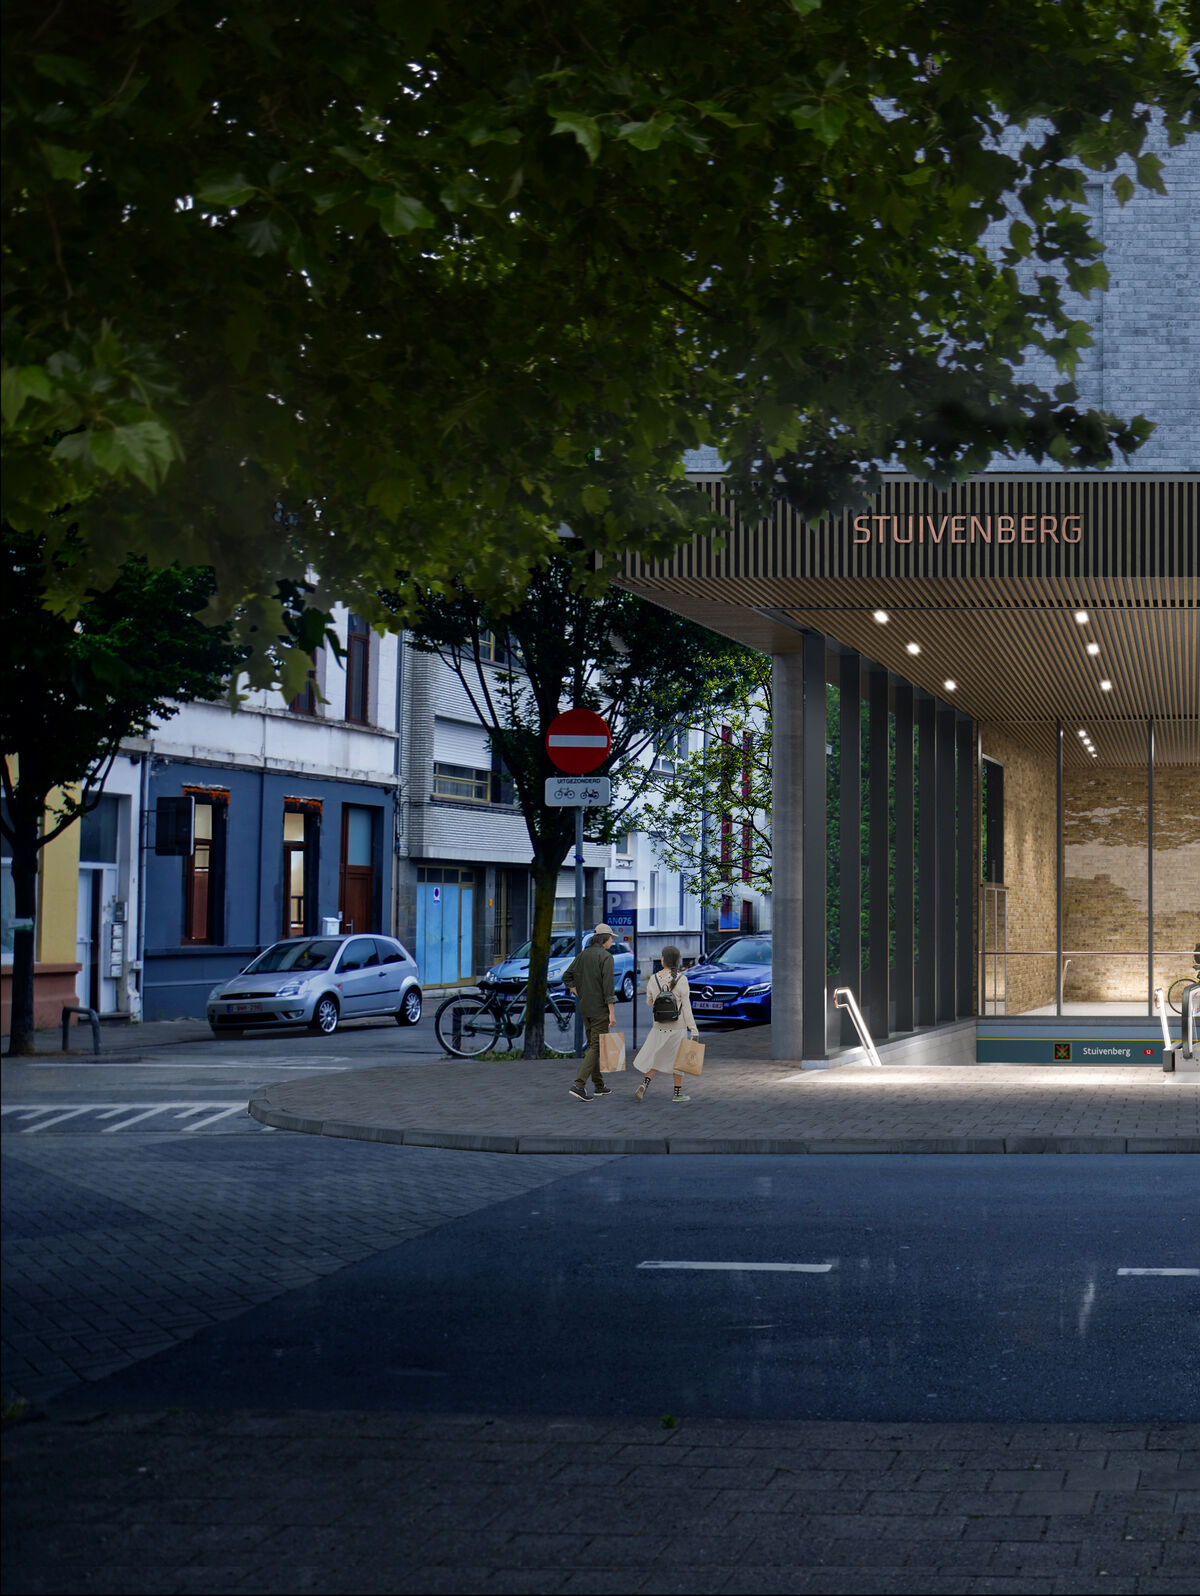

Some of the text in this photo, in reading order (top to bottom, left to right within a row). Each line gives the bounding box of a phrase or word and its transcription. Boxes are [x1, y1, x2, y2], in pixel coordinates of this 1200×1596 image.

[853, 515, 1082, 544] STUIVENBERG
[607, 893, 622, 913] P
[607, 917, 632, 925] AN076
[1083, 1047, 1131, 1057] Stuivenberg
